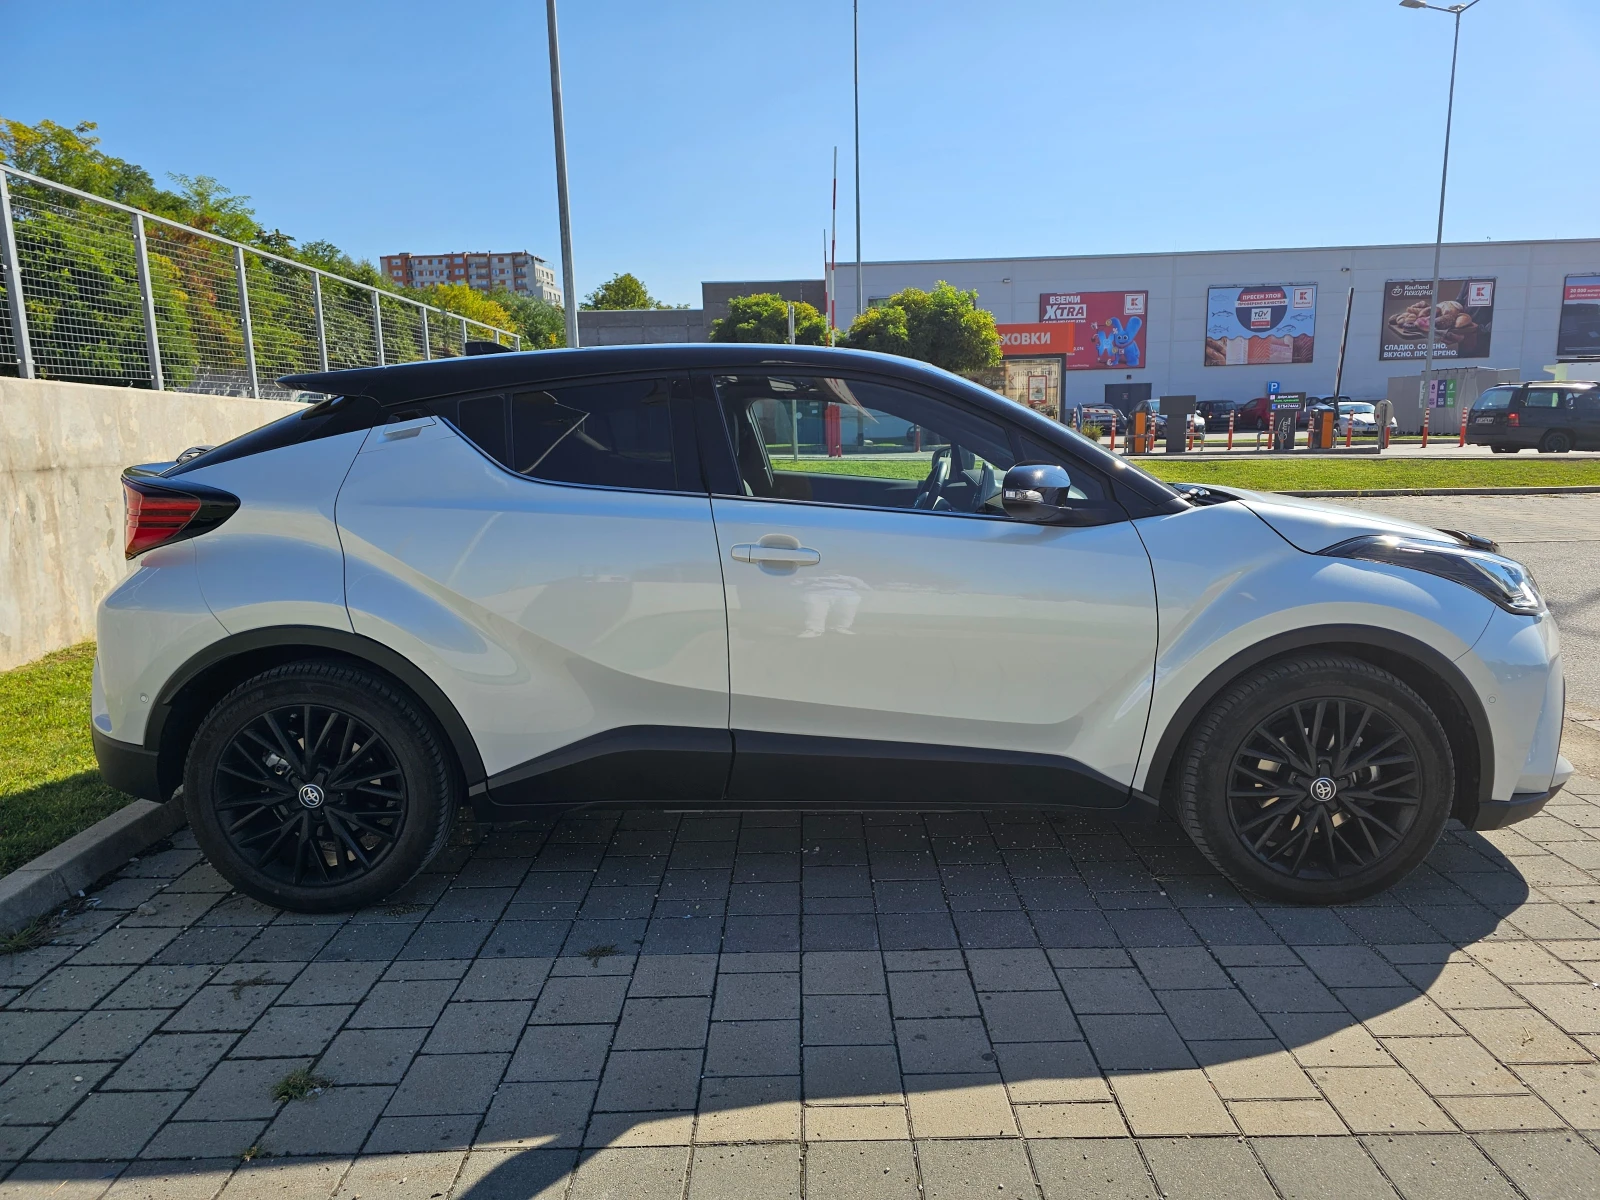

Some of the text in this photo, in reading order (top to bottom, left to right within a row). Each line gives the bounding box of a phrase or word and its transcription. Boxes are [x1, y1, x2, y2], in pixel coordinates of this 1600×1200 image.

[1049, 295, 1081, 304] ВЗЕМИ
[1043, 304, 1087, 319] XTRA
[1271, 383, 1278, 392] P
